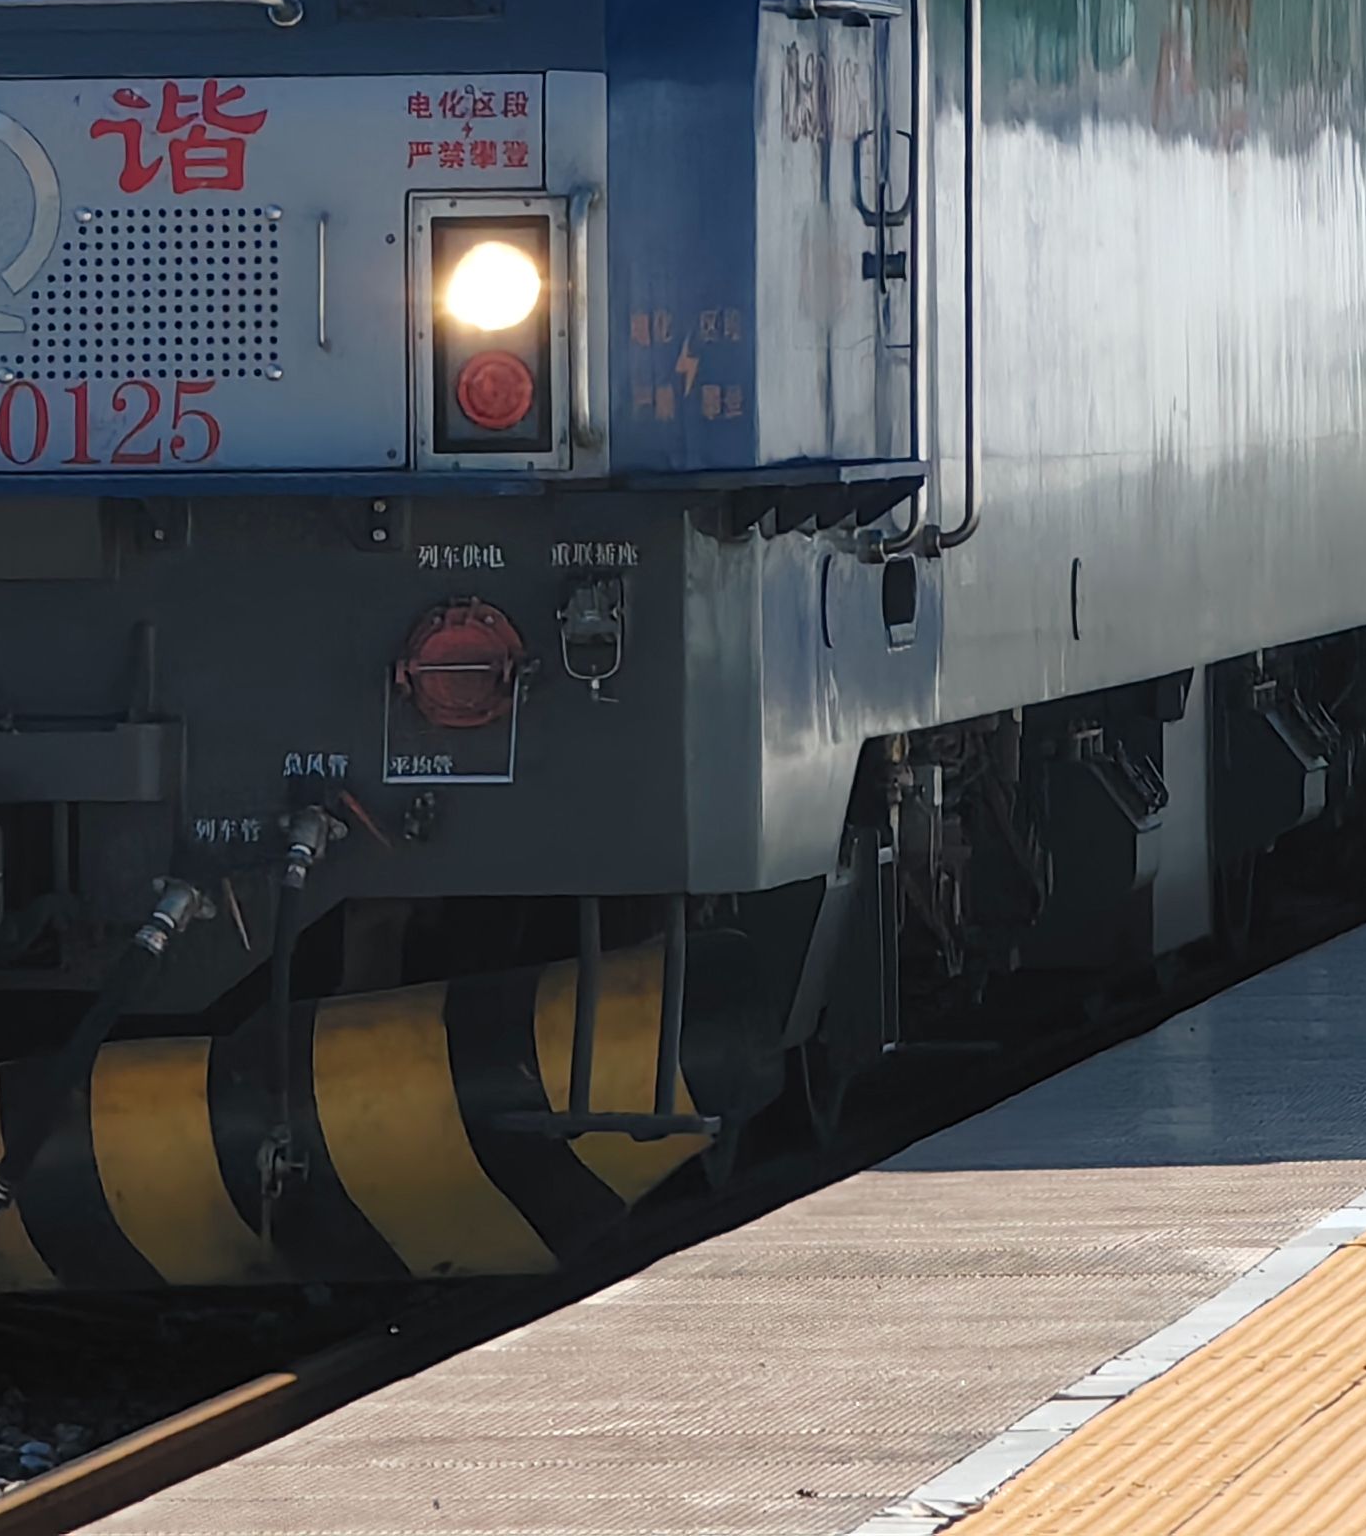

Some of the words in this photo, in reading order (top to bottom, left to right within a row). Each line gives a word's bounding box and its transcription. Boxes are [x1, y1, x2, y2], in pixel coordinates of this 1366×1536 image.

[407, 90, 530, 119] 电化区段
[89, 78, 269, 195] 谐
[407, 139, 529, 170] 严禁攀登
[418, 544, 505, 569] 列车供电
